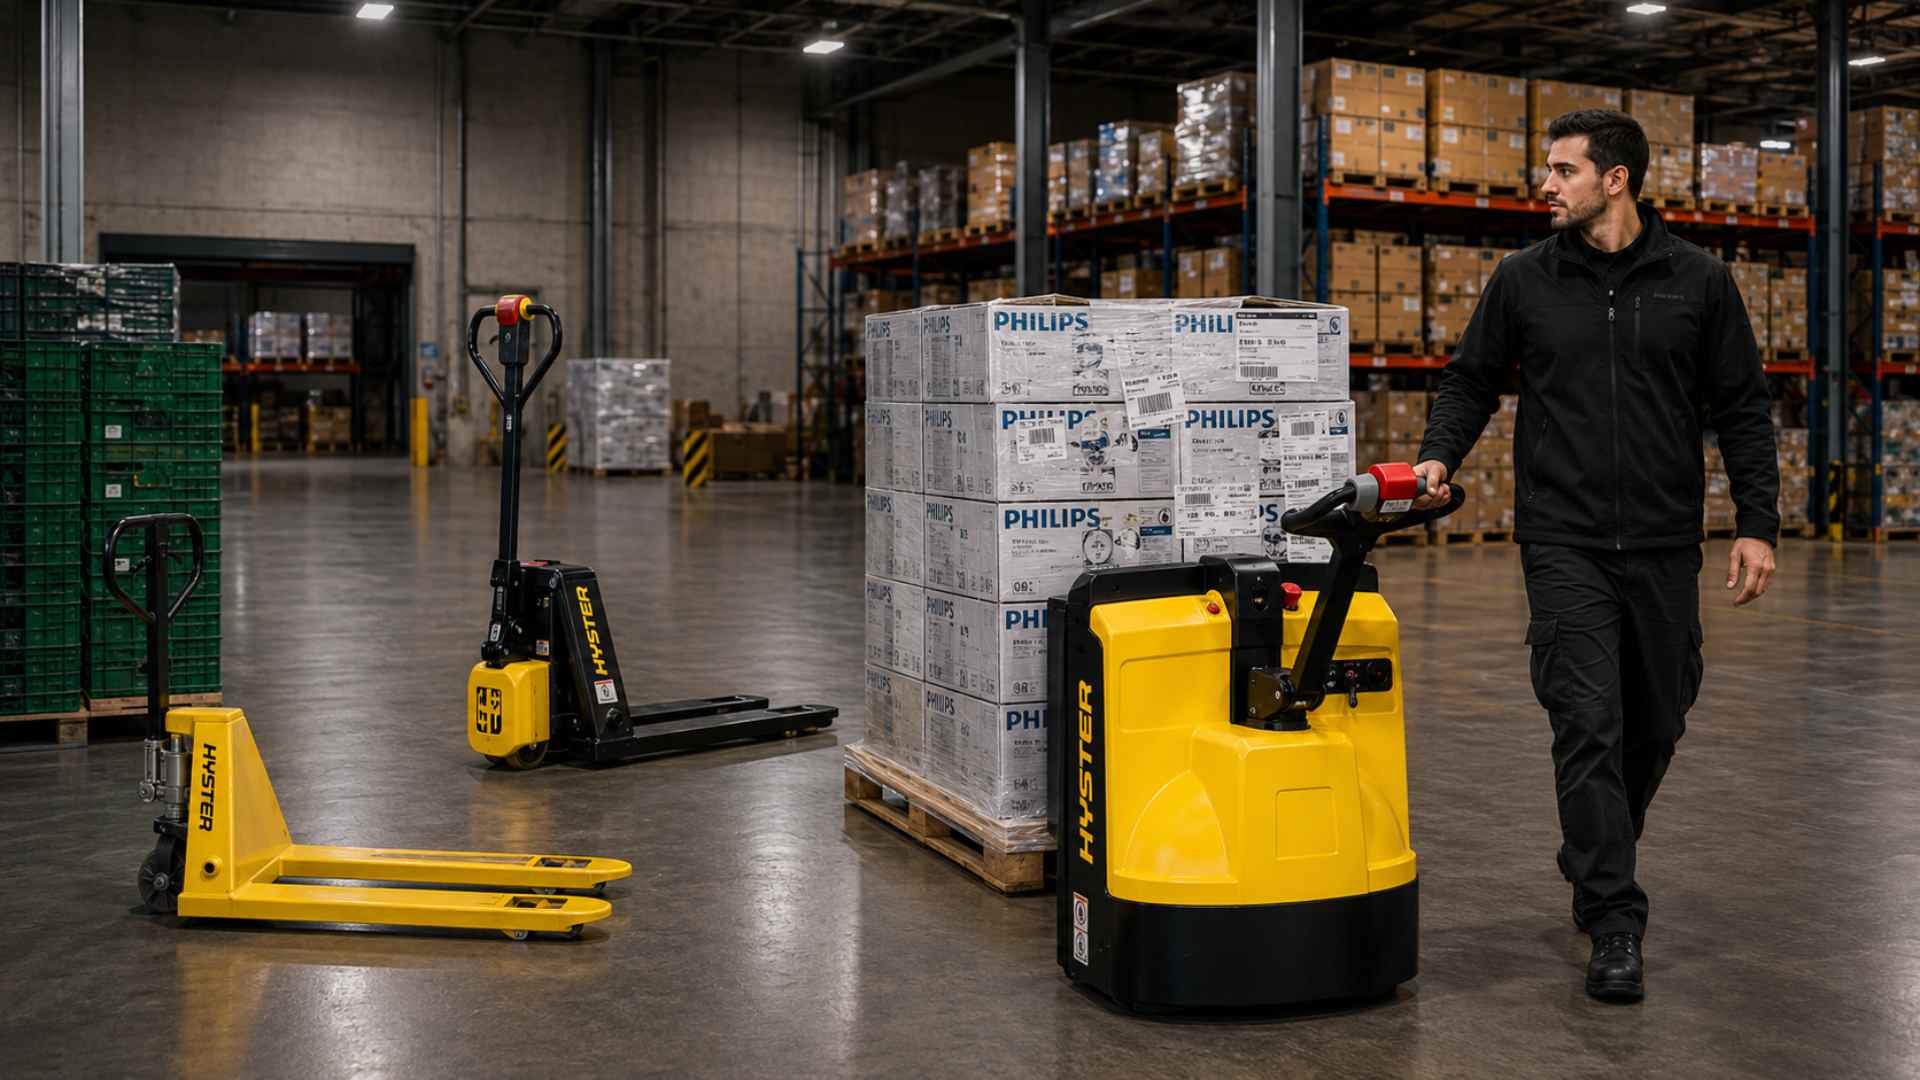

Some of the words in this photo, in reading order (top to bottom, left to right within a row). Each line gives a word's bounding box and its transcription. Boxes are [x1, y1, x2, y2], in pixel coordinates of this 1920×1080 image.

[994, 311, 1089, 332] PHILIPS
[1184, 409, 1275, 430] PHILIPS
[1004, 507, 1100, 530] PHILIPS
[576, 584, 609, 677] HYSTER
[199, 743, 217, 832] HYSTER
[1079, 680, 1093, 865] HYSTER
